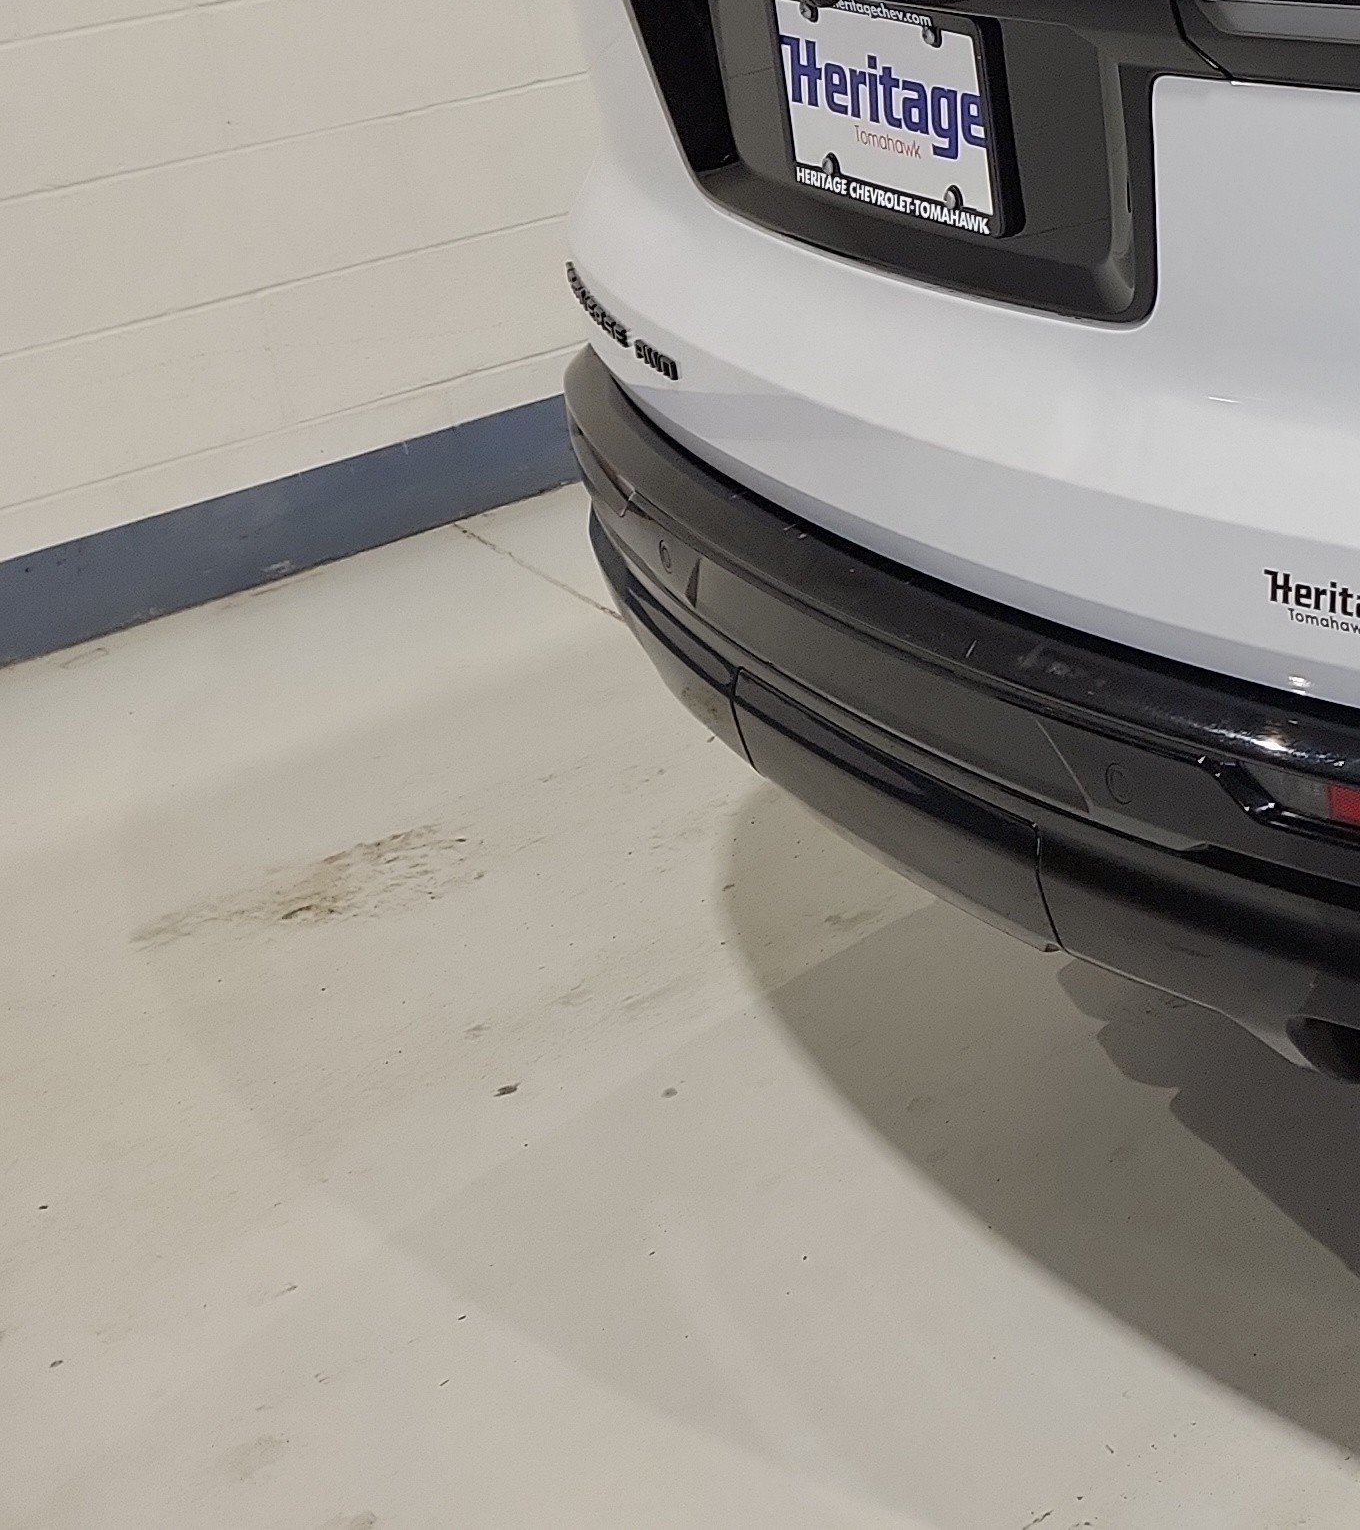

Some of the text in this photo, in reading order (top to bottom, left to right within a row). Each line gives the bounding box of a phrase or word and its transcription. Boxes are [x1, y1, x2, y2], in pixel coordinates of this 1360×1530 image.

[779, 34, 987, 160] Heritage
[854, 125, 922, 159] Tomahawk
[796, 166, 847, 195] HERITAGE
